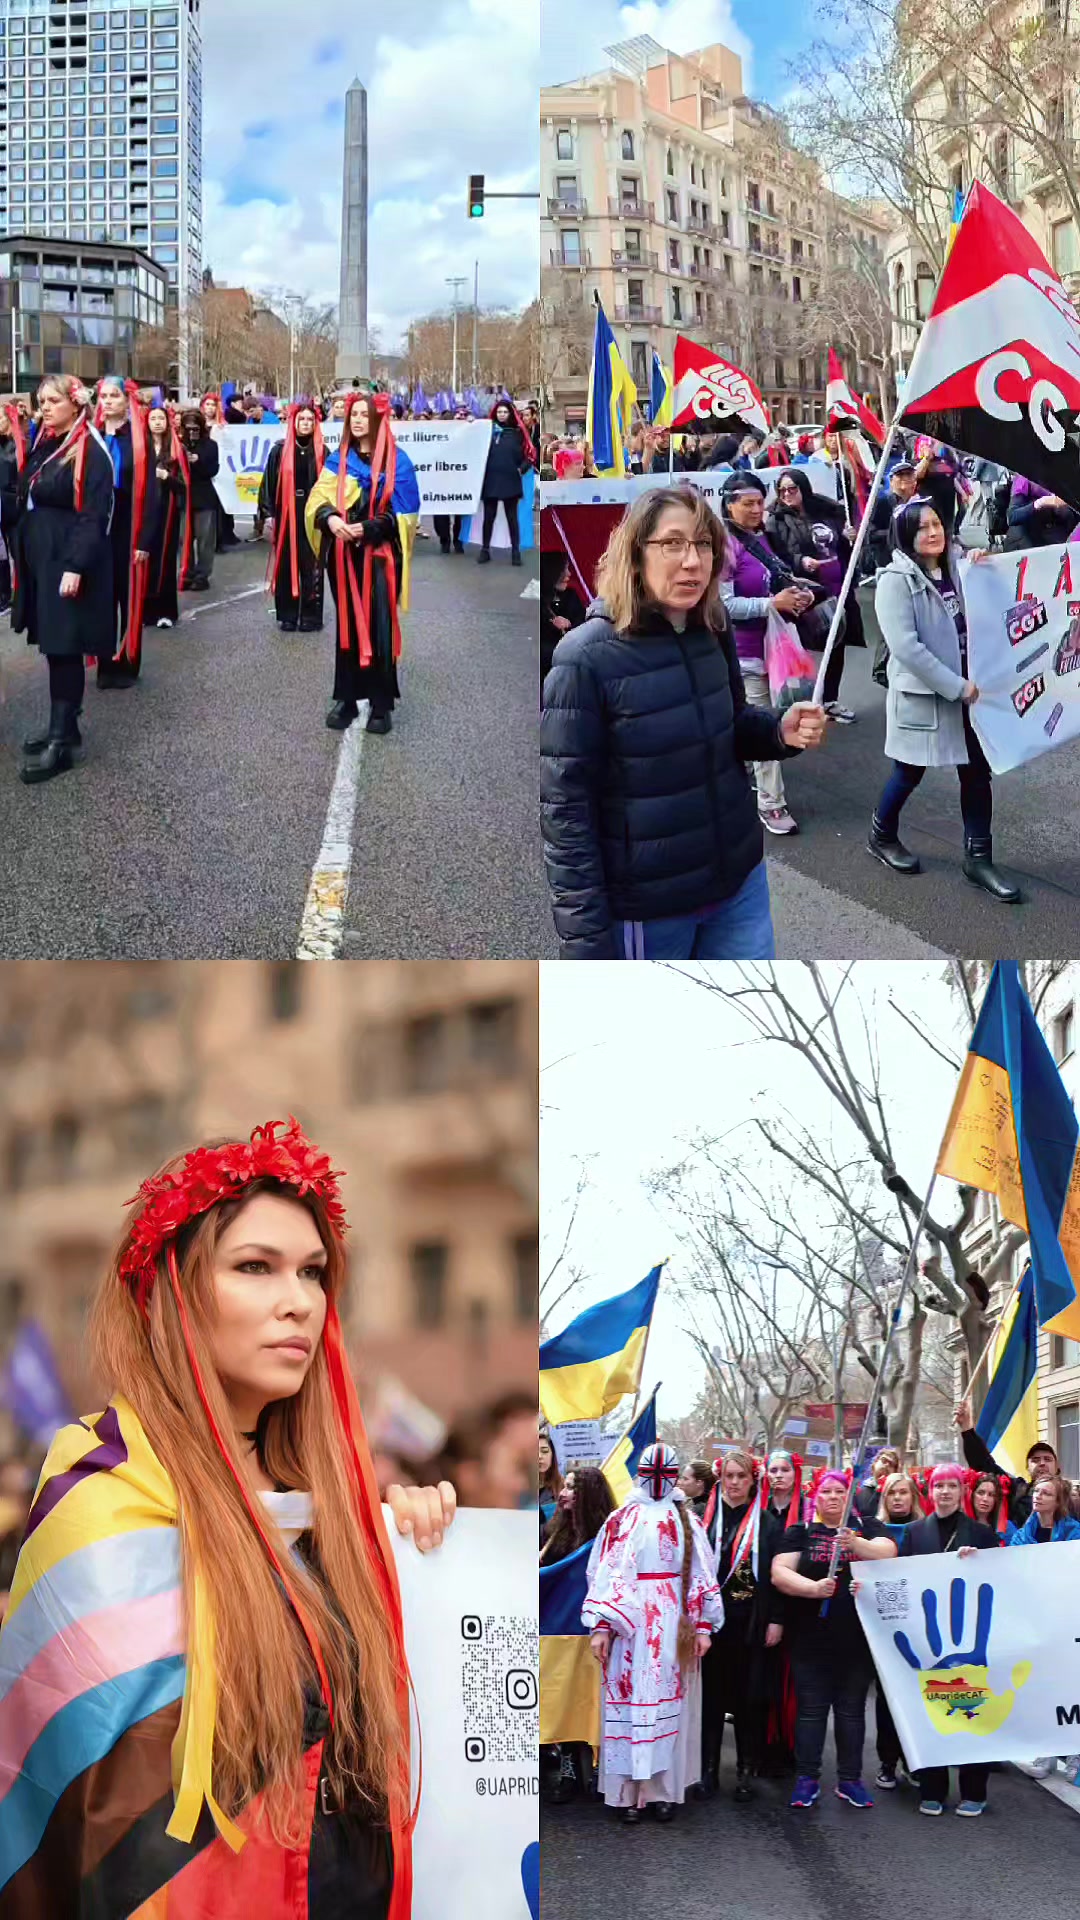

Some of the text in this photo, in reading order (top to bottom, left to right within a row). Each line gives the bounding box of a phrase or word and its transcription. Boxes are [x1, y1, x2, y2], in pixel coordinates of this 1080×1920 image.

[691, 389, 741, 419] CG
[974, 351, 1080, 452] CG
[435, 461, 468, 472] libres
[422, 491, 473, 501] вільним
[1009, 604, 1045, 641] CGT
[1014, 675, 1043, 711] CGT
[926, 1690, 984, 1701] UAprideCAT
[475, 1776, 539, 1796] @UAPRID
